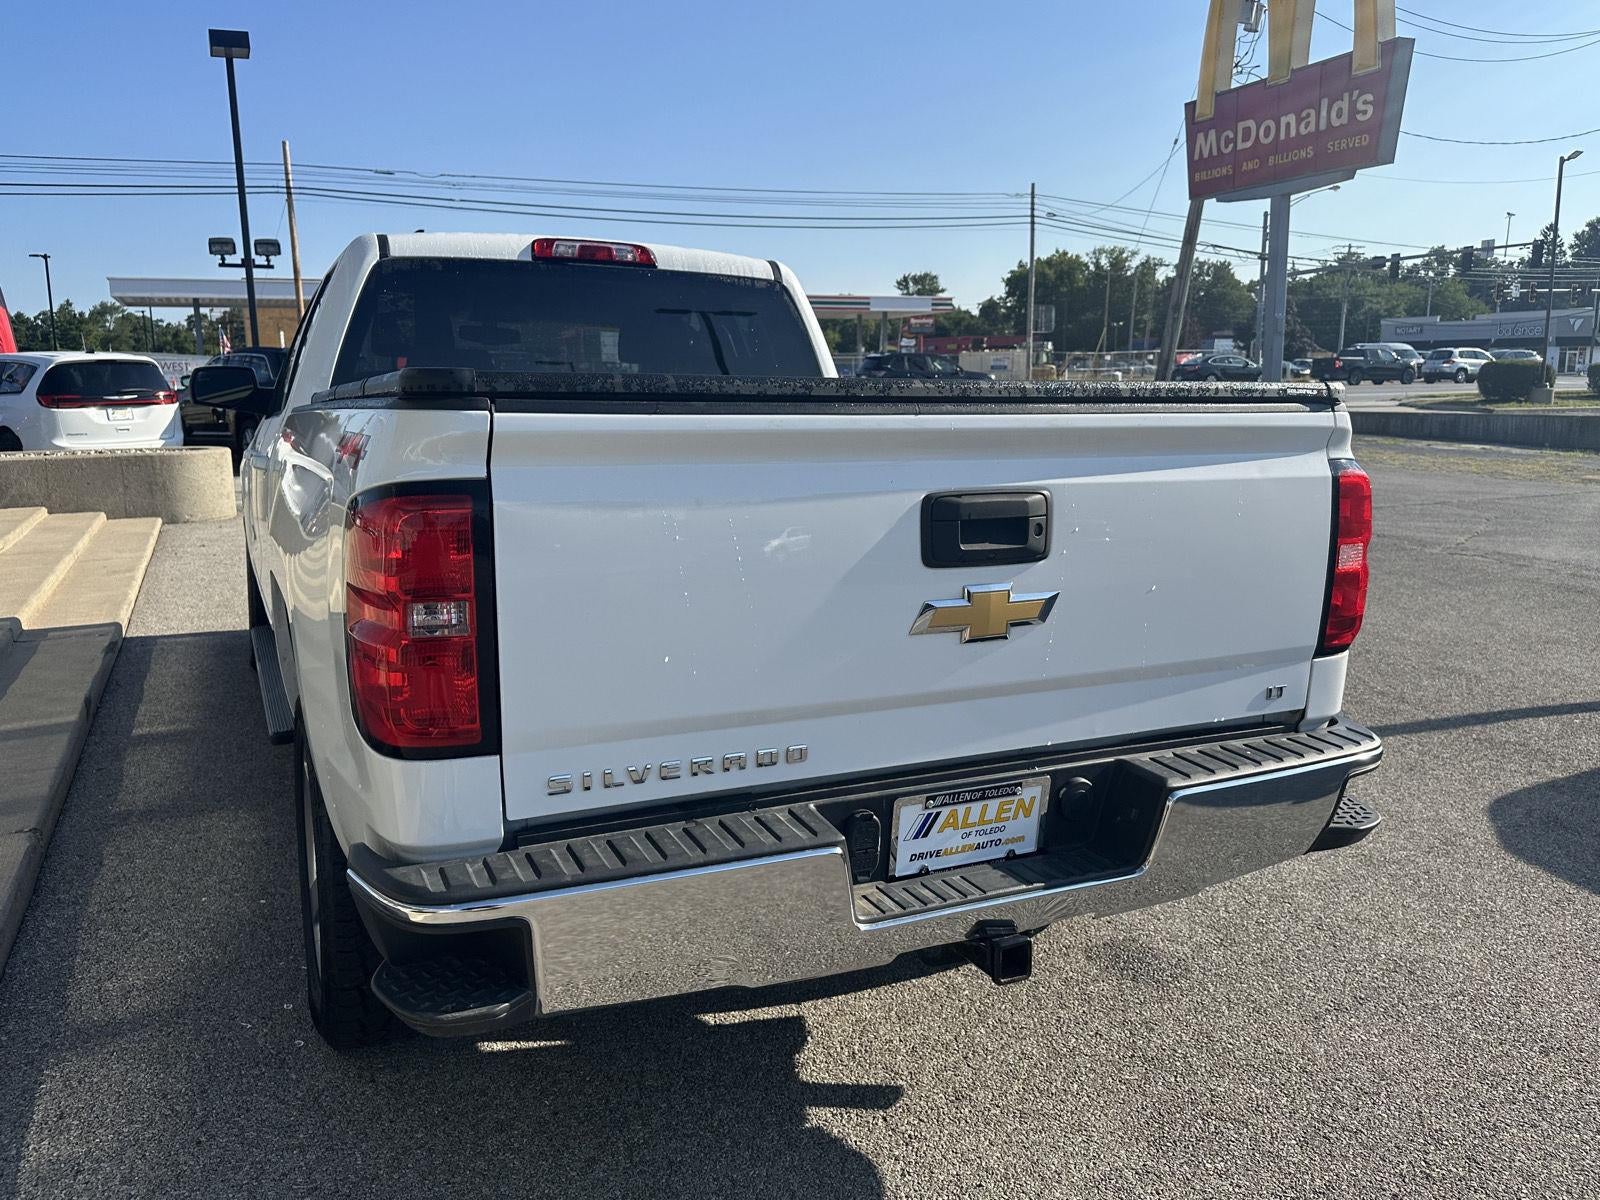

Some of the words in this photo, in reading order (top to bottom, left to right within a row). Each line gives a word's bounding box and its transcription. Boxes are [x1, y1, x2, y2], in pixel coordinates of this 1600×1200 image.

[1193, 90, 1375, 161] McDonald's
[1194, 164, 1233, 182] BILLIONS
[1241, 159, 1260, 172] AND
[1268, 146, 1314, 166] BILLIONS
[1327, 134, 1369, 153] SERVED
[1396, 327, 1422, 335] NOTARY
[1265, 685, 1287, 700] LT
[547, 743, 809, 796] SILVERADO
[971, 791, 983, 799] OF
[984, 786, 1015, 798] TOLEDO
[937, 796, 1036, 833] ALLEN
[961, 832, 973, 840] OF
[974, 825, 1006, 837] TOLEDO
